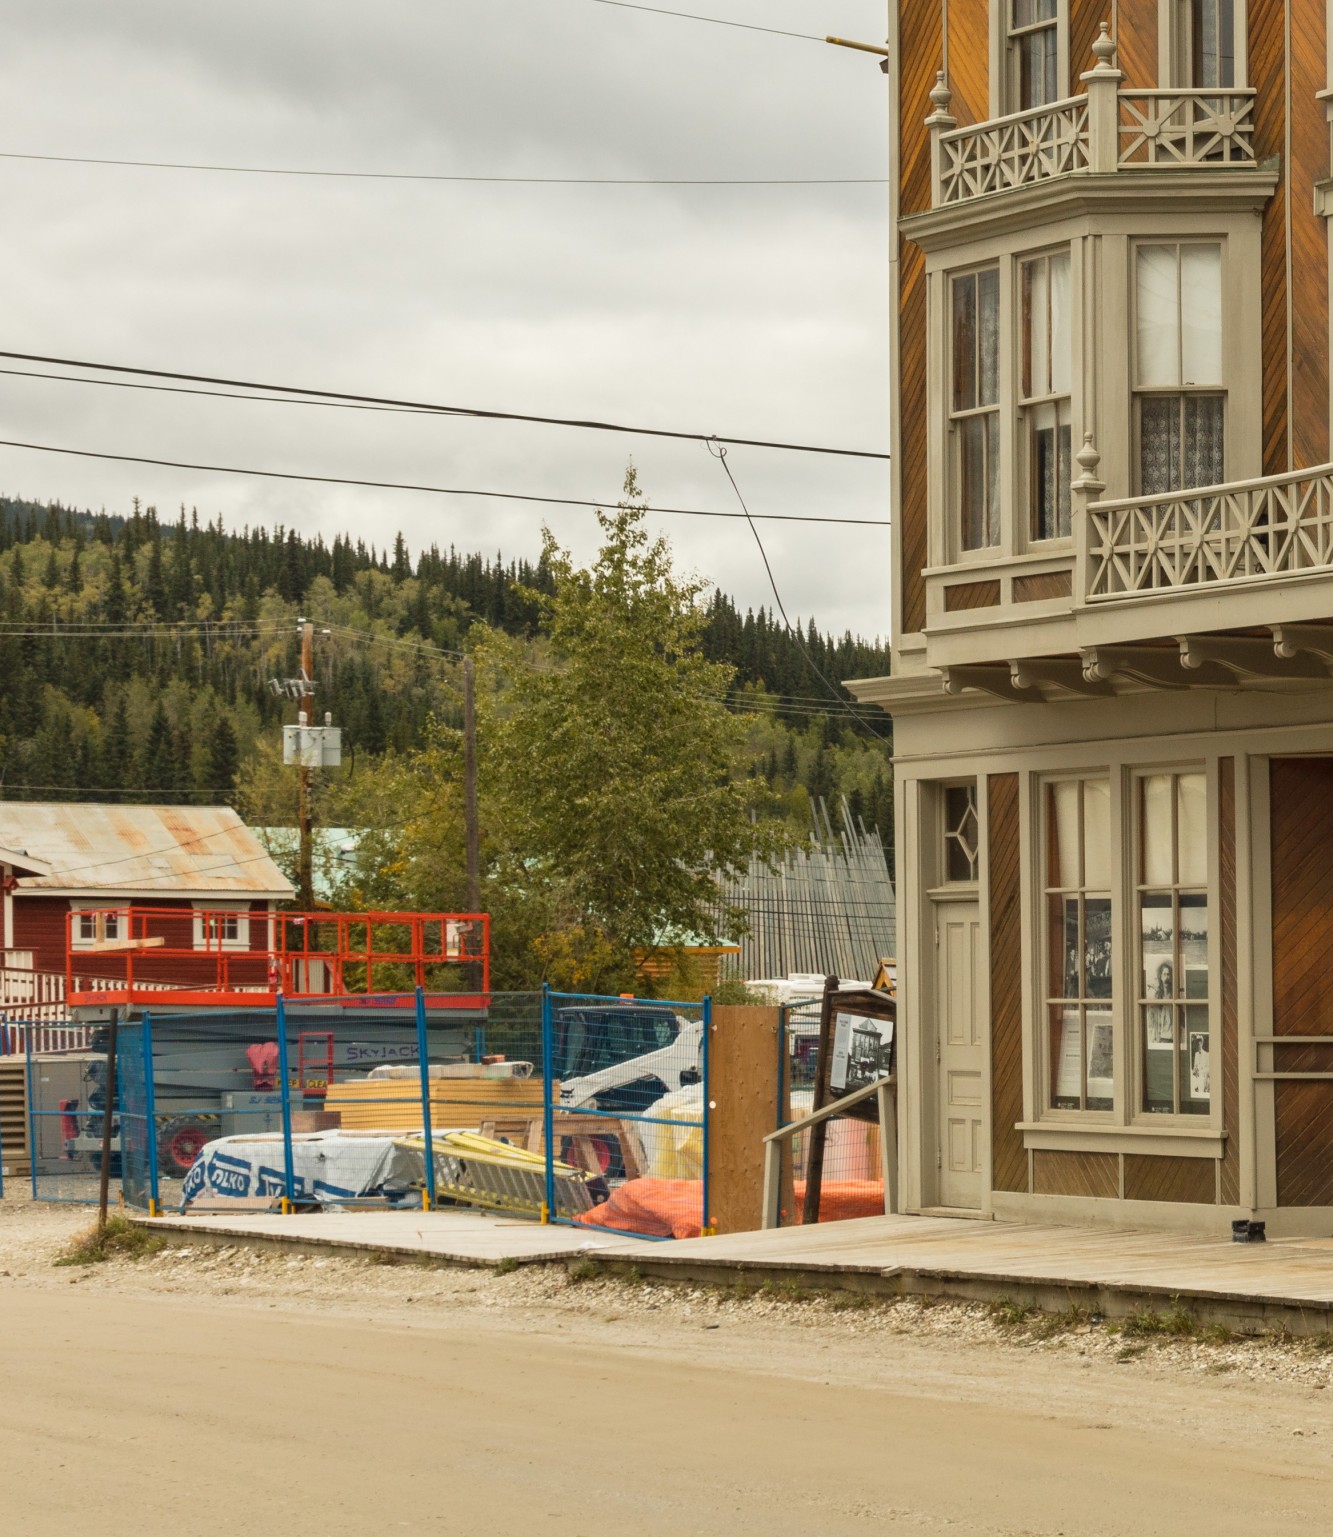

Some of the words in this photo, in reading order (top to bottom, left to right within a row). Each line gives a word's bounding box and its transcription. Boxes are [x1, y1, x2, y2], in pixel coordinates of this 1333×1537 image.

[346, 1045, 420, 1061] SKYJACK
[308, 1078, 328, 1089] CLEA
[211, 1166, 246, 1193] OLKO
